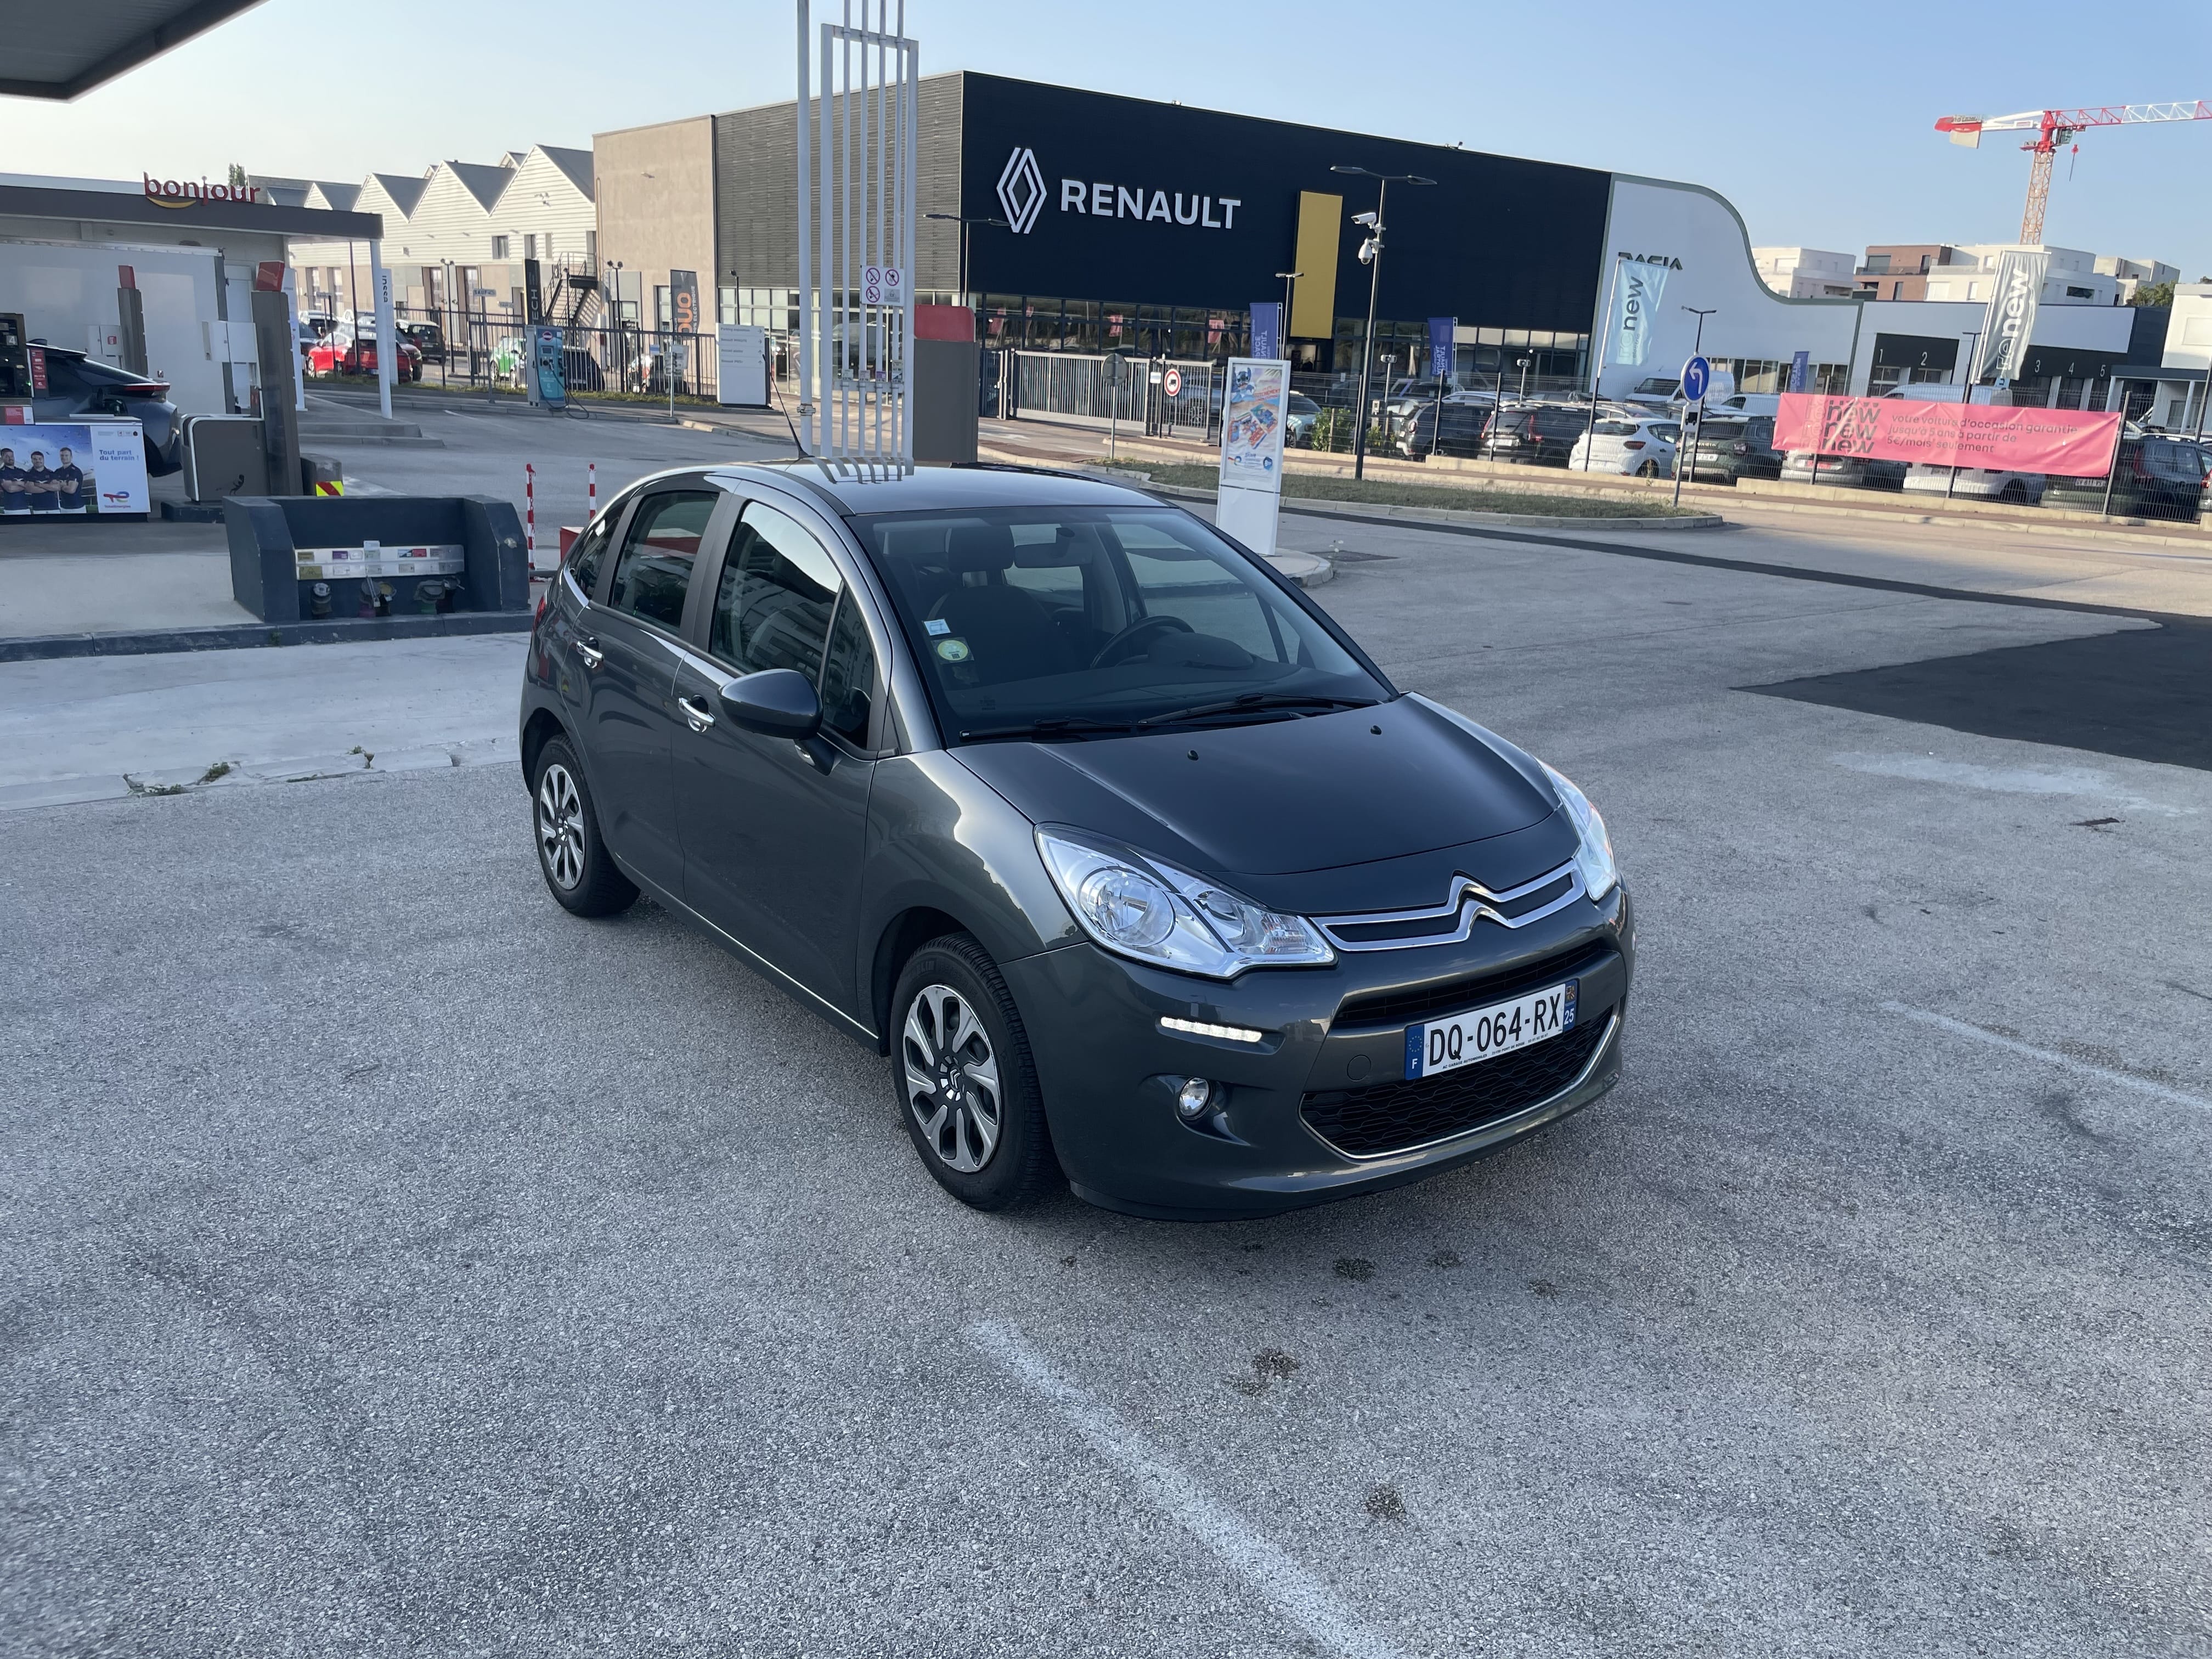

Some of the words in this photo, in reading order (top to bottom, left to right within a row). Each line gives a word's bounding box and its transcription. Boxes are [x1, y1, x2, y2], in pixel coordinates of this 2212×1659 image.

[143, 171, 261, 206] bonjour
[1061, 178, 1241, 229] RENAULT
[1618, 252, 1683, 270] DACIA
[531, 289, 539, 325] ECH
[1996, 268, 2029, 370] renew
[1879, 349, 1883, 363] 1
[1921, 352, 1927, 366] 2
[2034, 359, 2041, 373] 3
[2068, 362, 2074, 375] 4
[2100, 364, 2106, 377] 5
[1893, 415, 1919, 424] votre
[1921, 416, 1959, 426] voiture
[1960, 417, 2023, 431] d'occasion
[2025, 424, 2078, 435] garantie
[1937, 430, 1955, 438] ans
[1957, 430, 1965, 438] à
[1966, 431, 2000, 442] partir
[2002, 433, 2017, 443] de
[1936, 441, 1994, 453] seulement
[1564, 1008, 1575, 1025] 25
[1429, 993, 1561, 1066] DQ-064-RX
[1412, 1058, 1418, 1069] F
